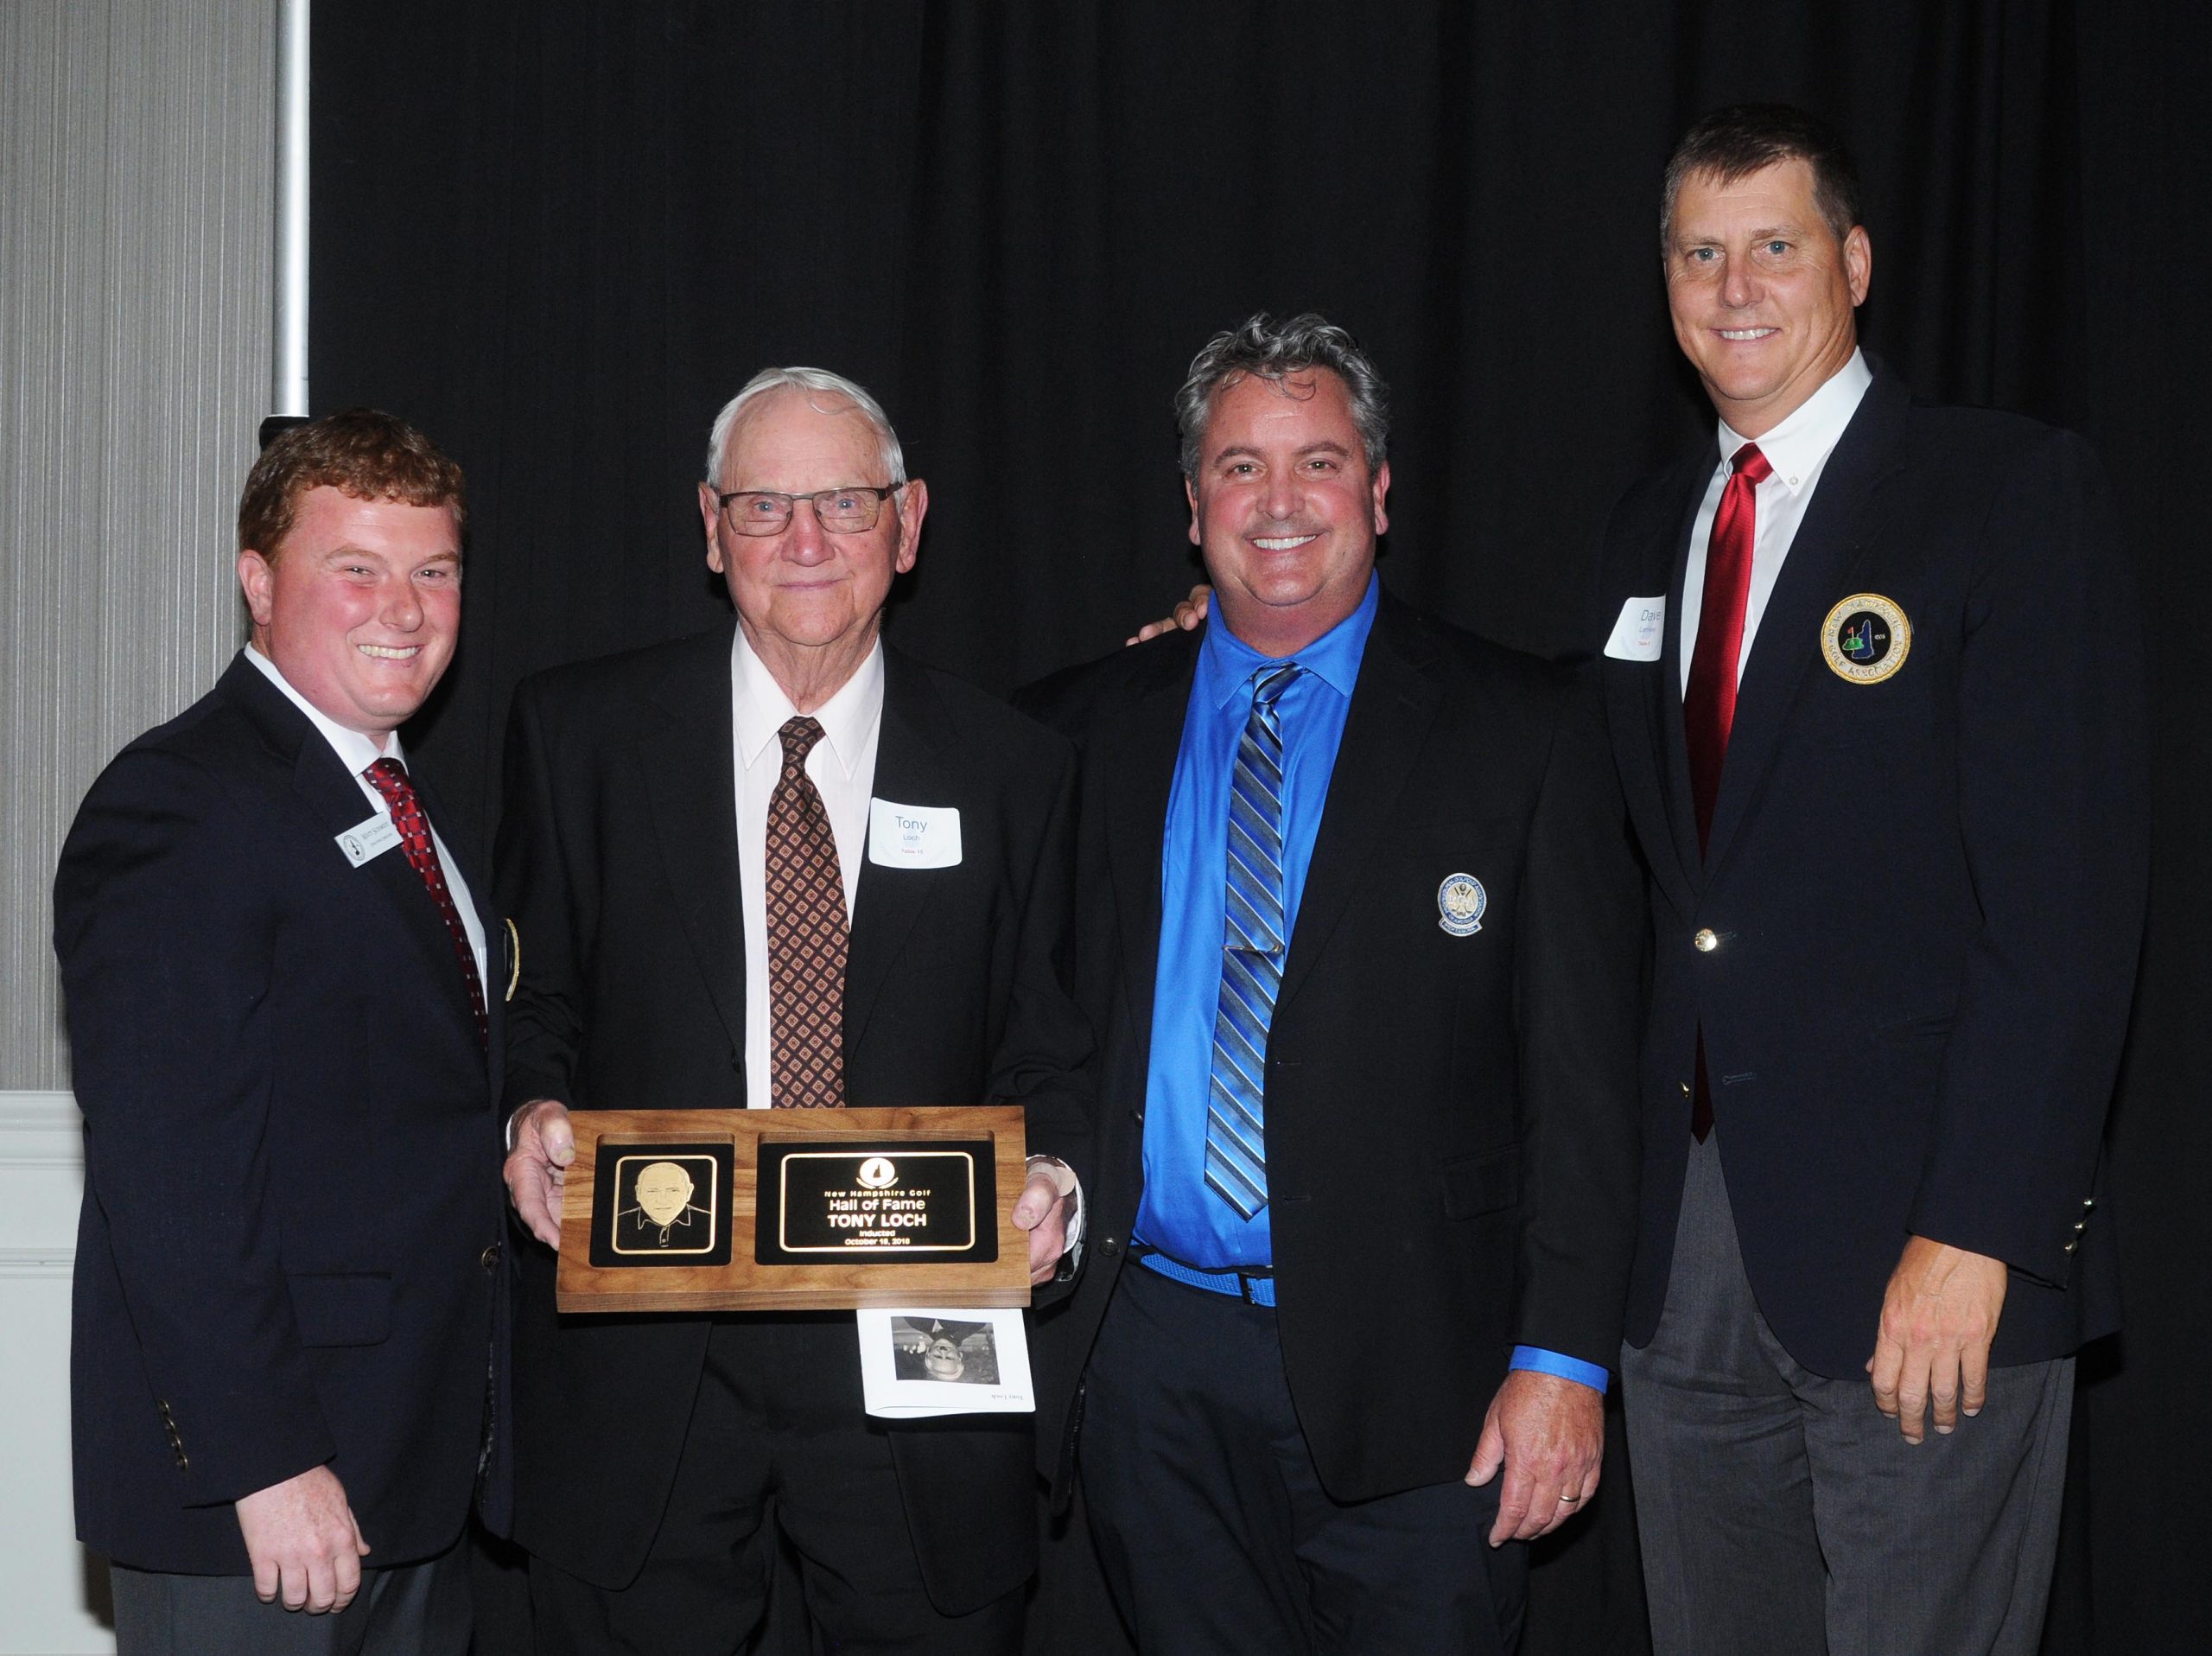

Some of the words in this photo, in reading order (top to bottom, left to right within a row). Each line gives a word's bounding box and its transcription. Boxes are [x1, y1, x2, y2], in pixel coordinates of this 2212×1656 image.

[1829, 645, 1847, 666] GOLF
[895, 815, 927, 833] Tony
[850, 1189, 906, 1198] Hampshire
[830, 1199, 858, 1211] Hall
[861, 1198, 880, 1211] of
[882, 1198, 925, 1210] Fame
[827, 1214, 876, 1227] TONY
[881, 1213, 927, 1227] LOCH
